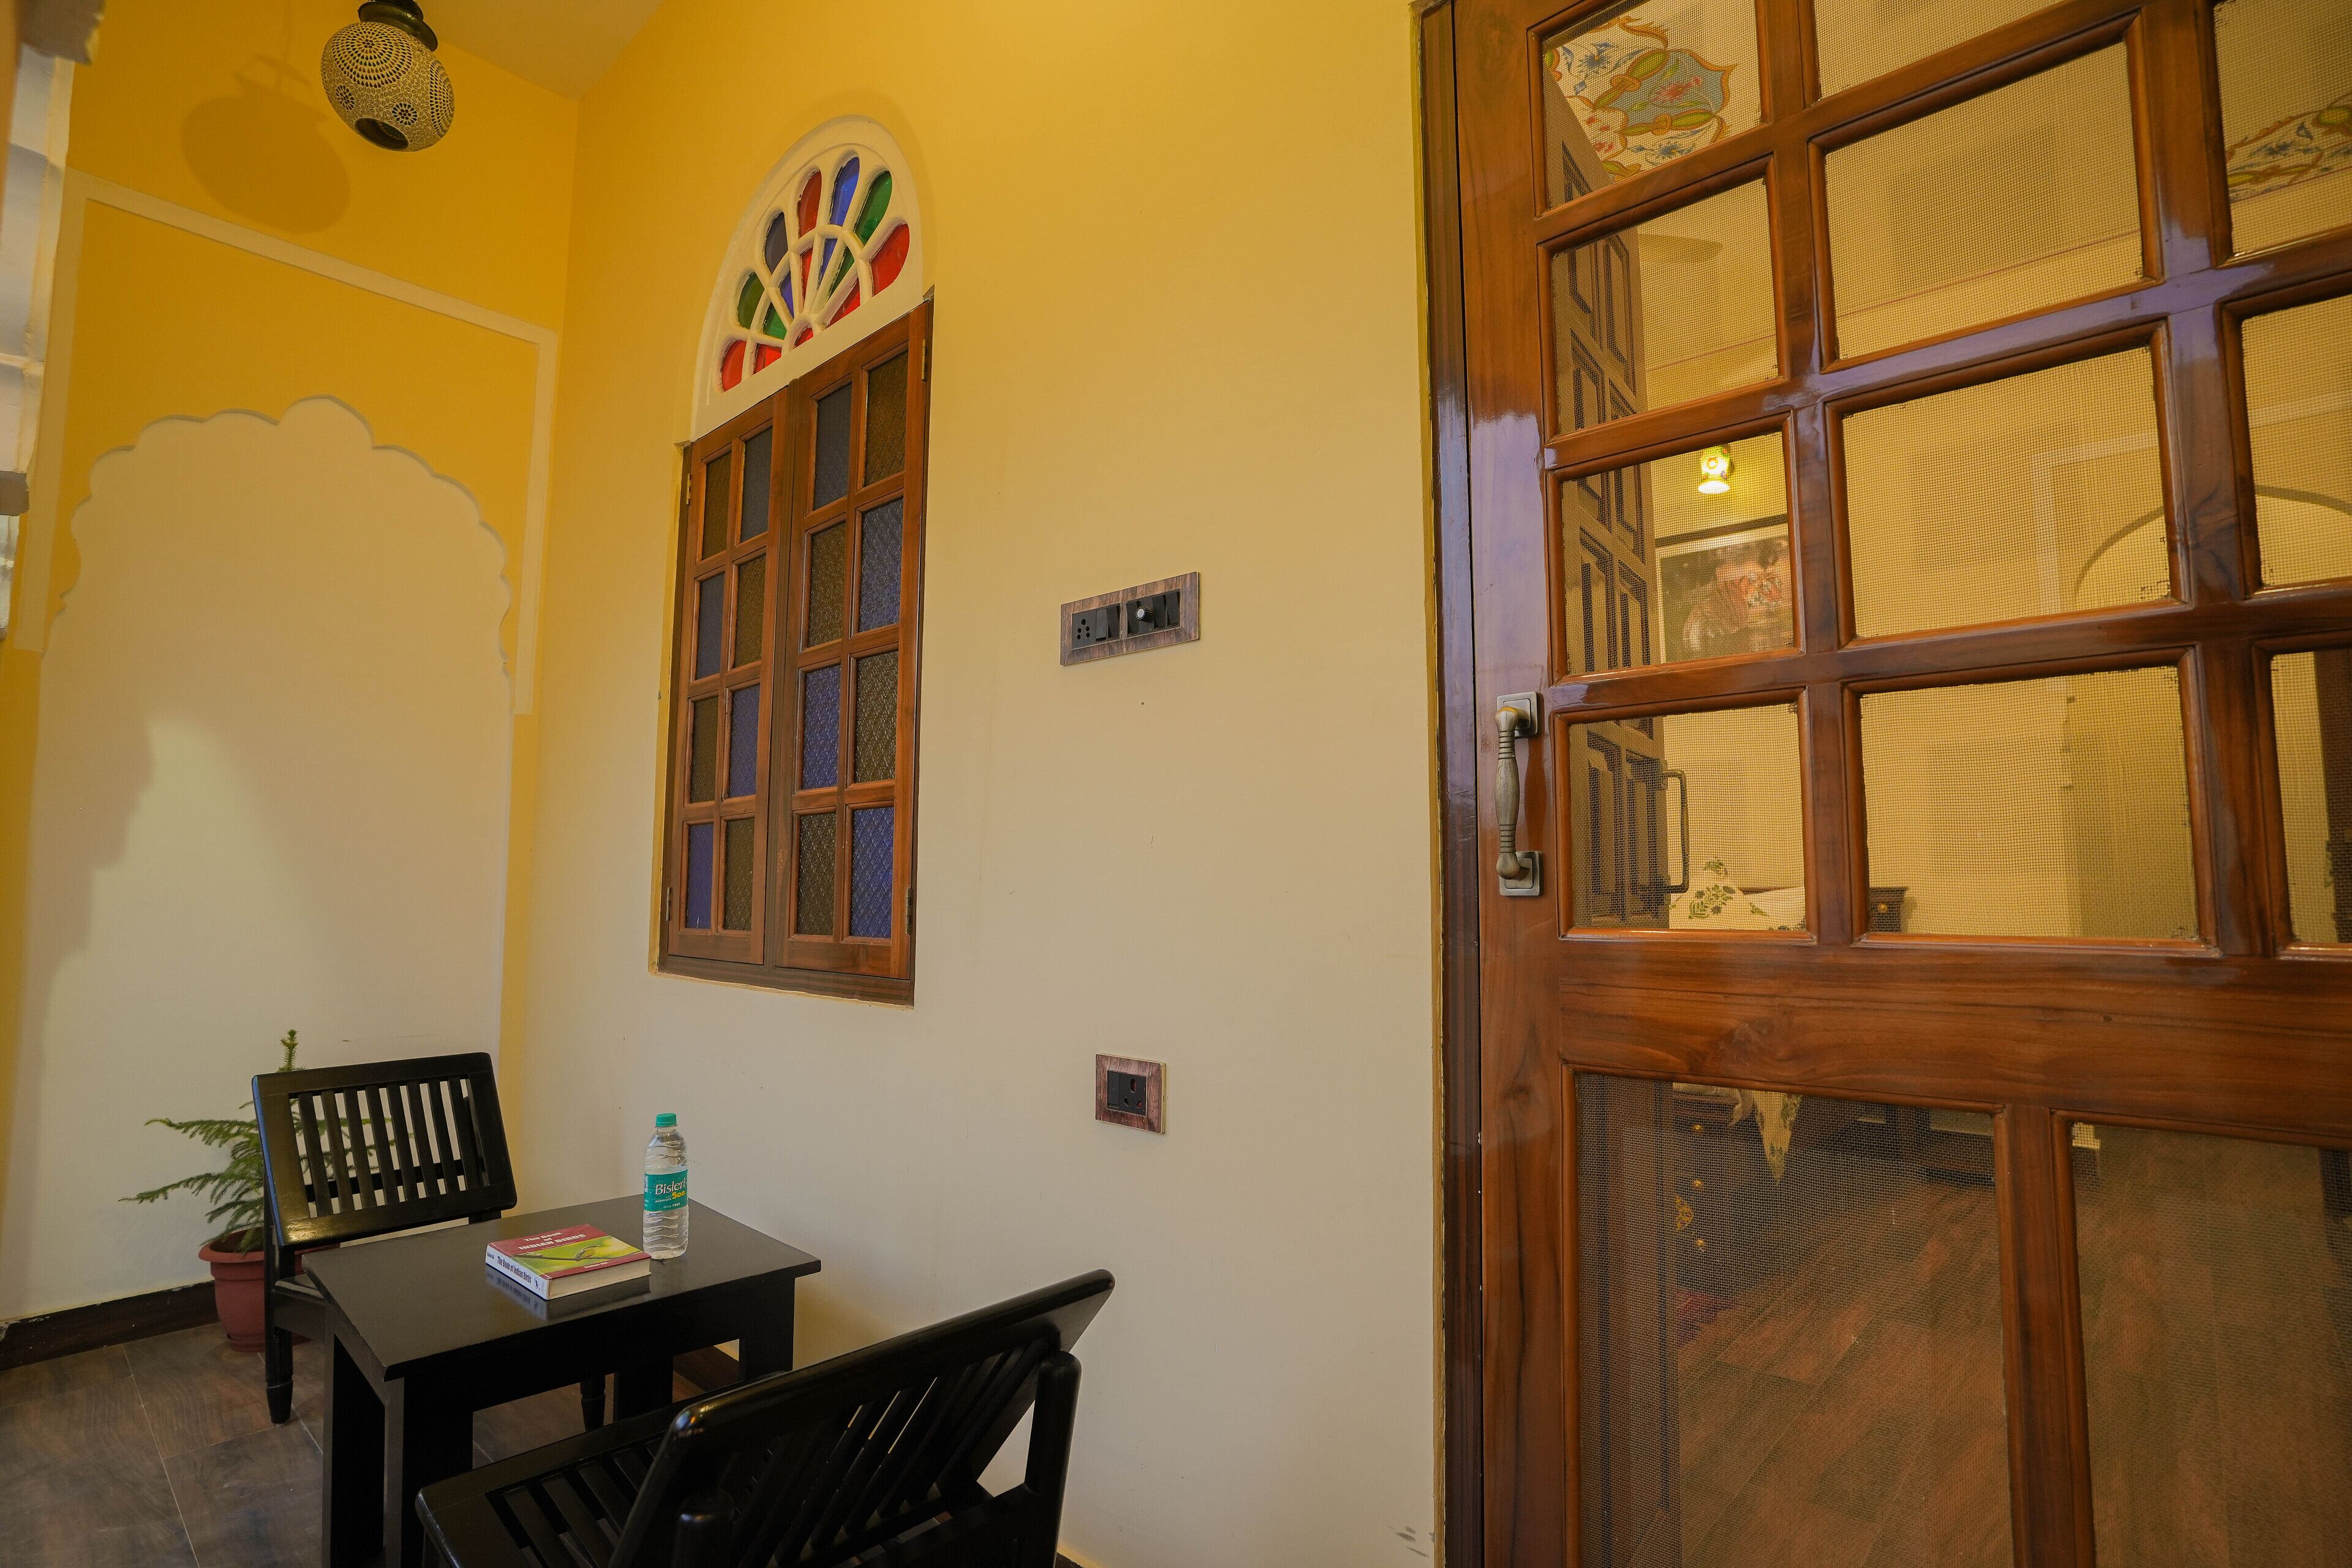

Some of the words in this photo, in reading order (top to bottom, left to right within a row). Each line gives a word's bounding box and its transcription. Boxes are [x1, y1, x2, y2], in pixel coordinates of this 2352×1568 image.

[655, 1178, 686, 1195] Bisleri
[518, 1241, 555, 1250] INDIAN
[554, 1234, 586, 1243] BIRDS
[510, 1264, 514, 1273] of
[513, 1265, 524, 1279] Indian
[523, 1271, 532, 1284] Birds
